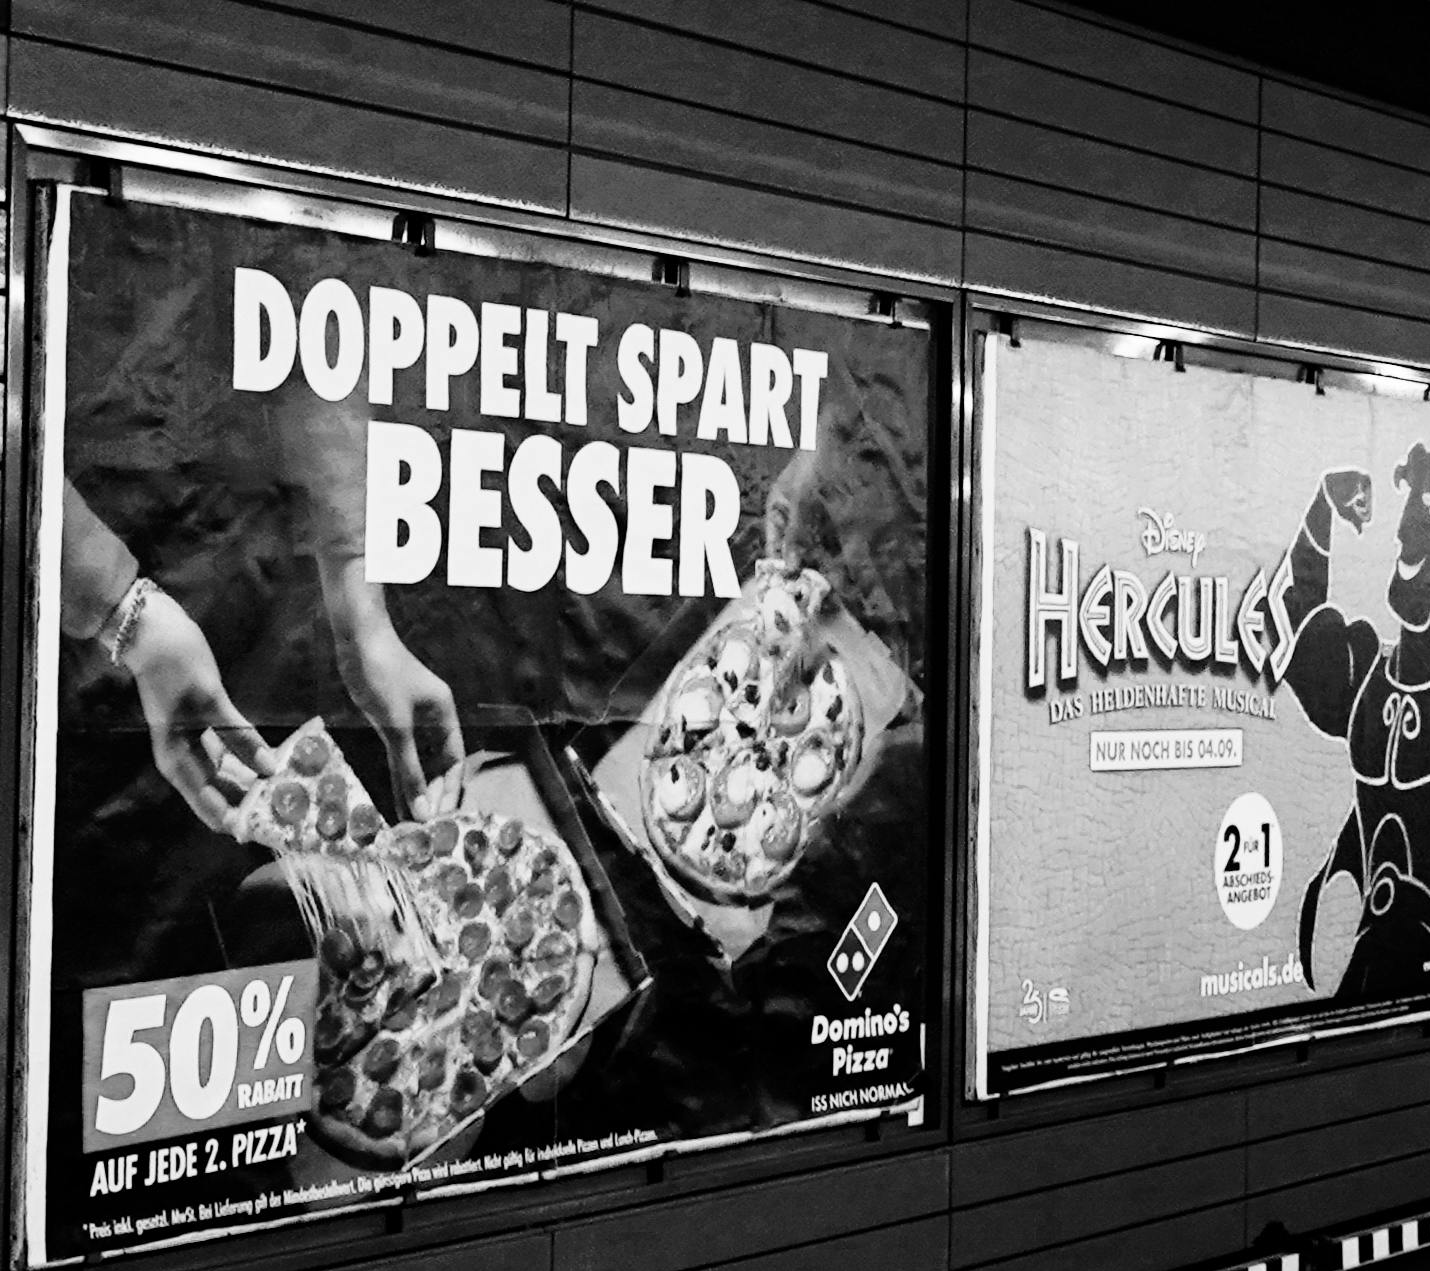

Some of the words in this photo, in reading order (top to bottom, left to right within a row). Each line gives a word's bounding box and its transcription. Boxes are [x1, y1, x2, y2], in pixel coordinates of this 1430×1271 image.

[233, 266, 599, 426] DOPPELT
[617, 323, 828, 451] SPART
[364, 420, 742, 598] BESSER
[1136, 507, 1207, 569] Disney
[1027, 526, 1295, 690] HERCULES
[1050, 694, 1085, 724] DAS
[1090, 683, 1206, 715] HELDENHAFTE
[1212, 686, 1276, 719] MUSICAL
[1096, 741, 1126, 761] NUR
[1130, 740, 1170, 761] NOCH
[1175, 739, 1193, 759] BIS
[1199, 738, 1238, 759] 04.09.
[1224, 824, 1241, 872] 2
[1261, 823, 1270, 868] 1
[1227, 887, 1272, 904] ANGEBOT
[1200, 953, 1303, 997] musicals.de
[811, 1003, 910, 1044] Domino's
[95, 975, 305, 1135] 50%
[832, 1044, 891, 1077] Pizza
[237, 1073, 304, 1109] RABATT
[811, 1095, 828, 1113] ISS
[829, 1091, 858, 1110] NICH
[859, 1082, 914, 1104] NORMAL
[90, 1154, 139, 1197] AUF
[144, 1142, 198, 1186] JEDE
[205, 1138, 227, 1174] 2.
